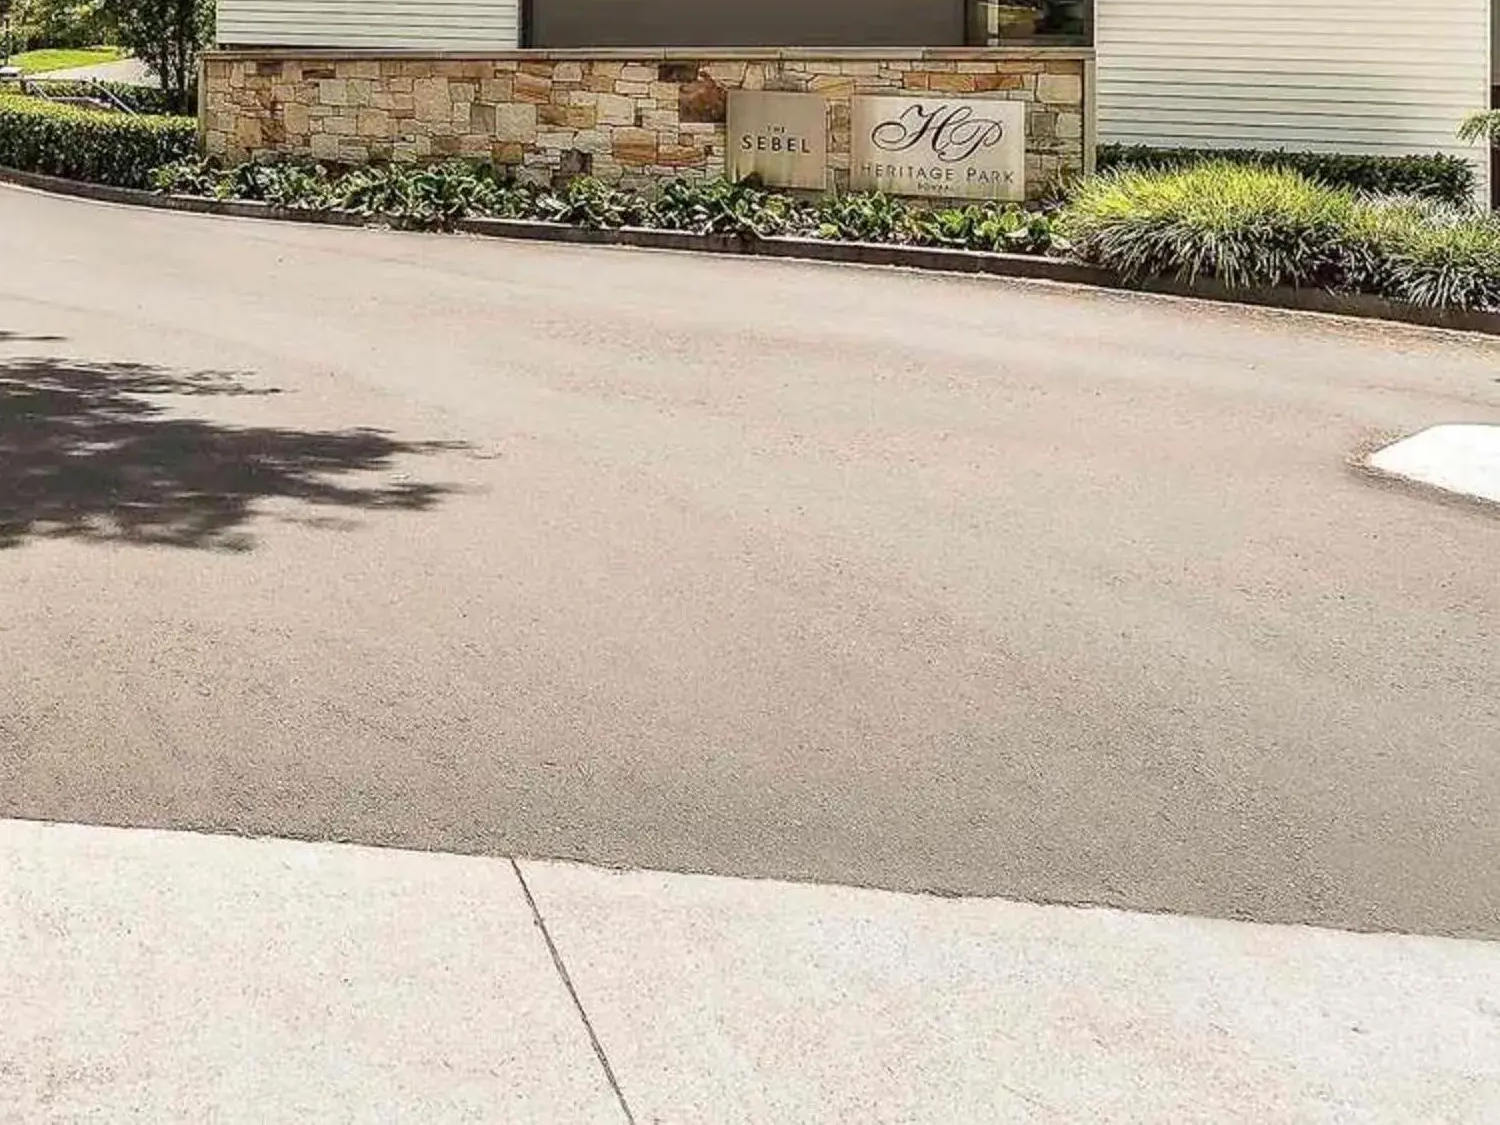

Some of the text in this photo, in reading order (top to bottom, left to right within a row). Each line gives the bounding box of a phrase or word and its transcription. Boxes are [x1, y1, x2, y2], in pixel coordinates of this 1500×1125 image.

[871, 104, 1003, 163] HP
[741, 135, 810, 154] SEBEL
[861, 164, 1014, 184] HERITAGE PARK
